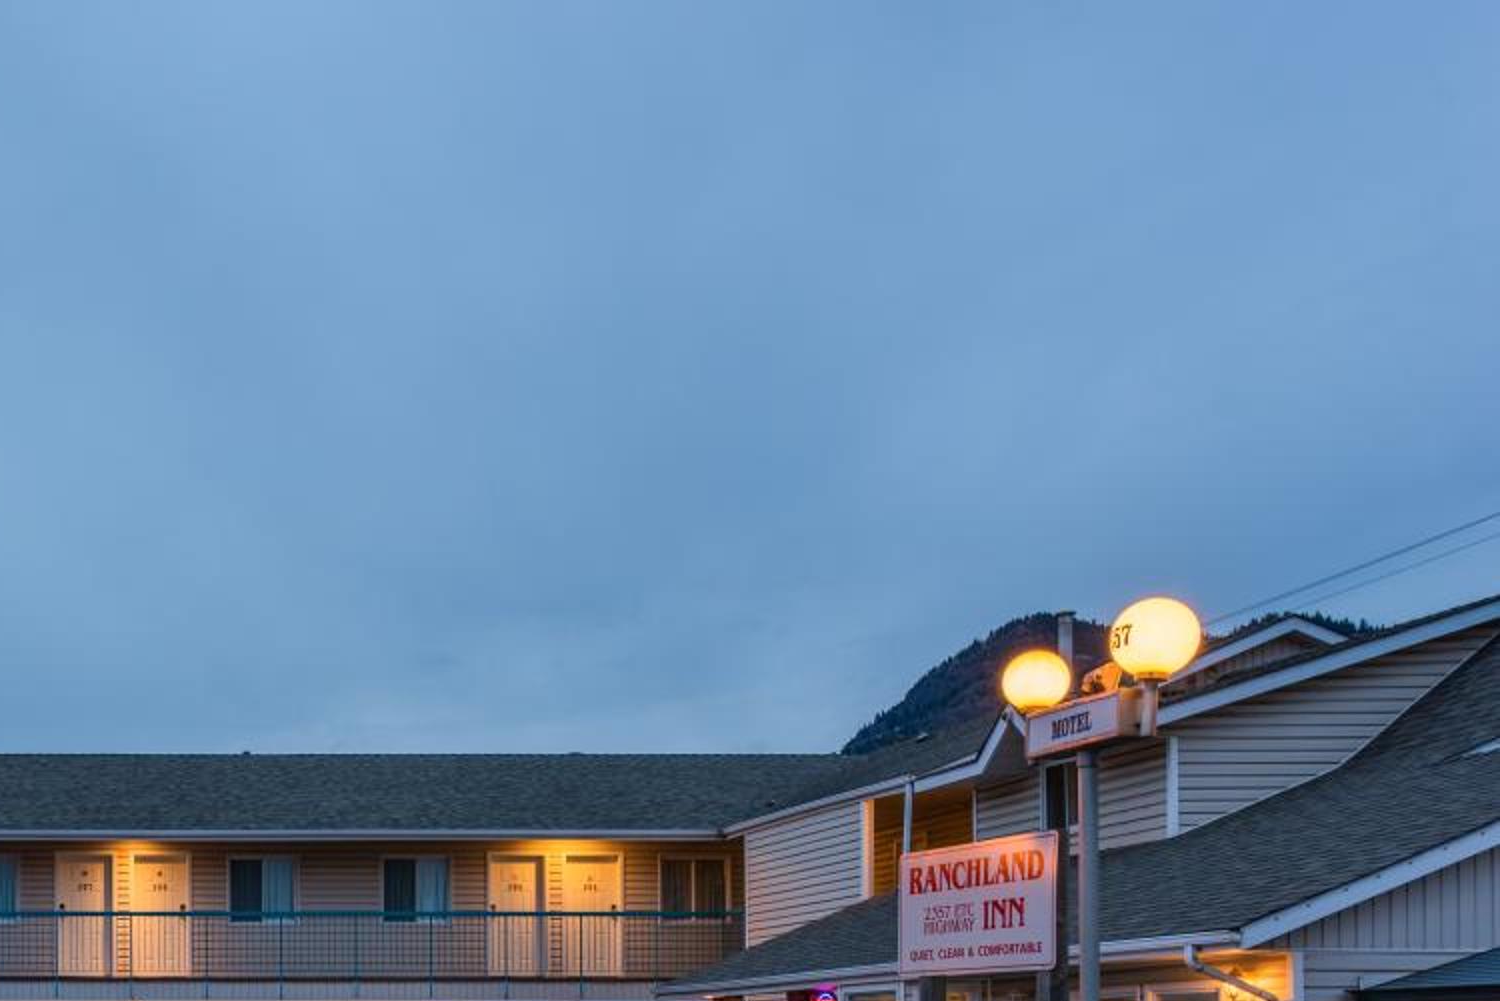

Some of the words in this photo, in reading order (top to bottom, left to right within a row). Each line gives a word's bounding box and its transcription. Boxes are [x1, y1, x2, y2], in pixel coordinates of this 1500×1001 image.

[1051, 711, 1093, 740] MOTEL
[909, 850, 1045, 895] RANCHLAND
[983, 897, 1026, 930] INN
[938, 946, 965, 959] CLEAN
[978, 941, 1043, 957] COMFORTABLE
